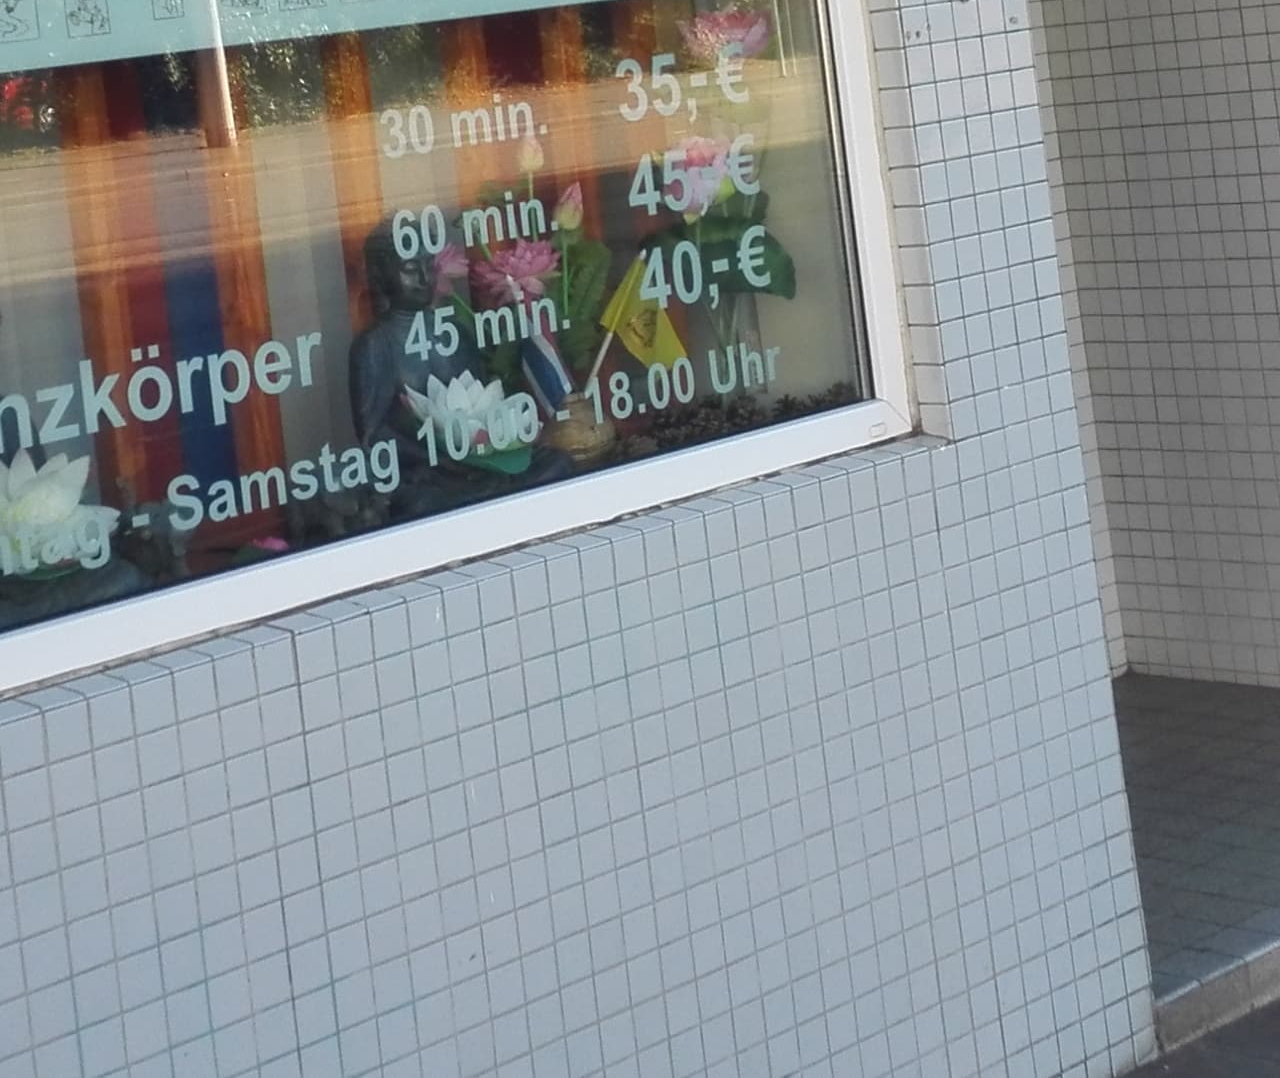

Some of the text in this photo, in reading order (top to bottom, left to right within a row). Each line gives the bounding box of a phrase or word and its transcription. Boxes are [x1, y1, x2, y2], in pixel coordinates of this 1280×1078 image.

[380, 104, 435, 160] 30
[451, 93, 549, 148] min.
[392, 204, 446, 260] 60
[462, 191, 559, 247] min.
[404, 305, 460, 361] 45
[474, 291, 570, 349] min.
[167, 439, 401, 532] Samstag
[417, 391, 540, 467] 10.00
[584, 356, 695, 425] 18.00
[708, 341, 781, 394] Uhr
